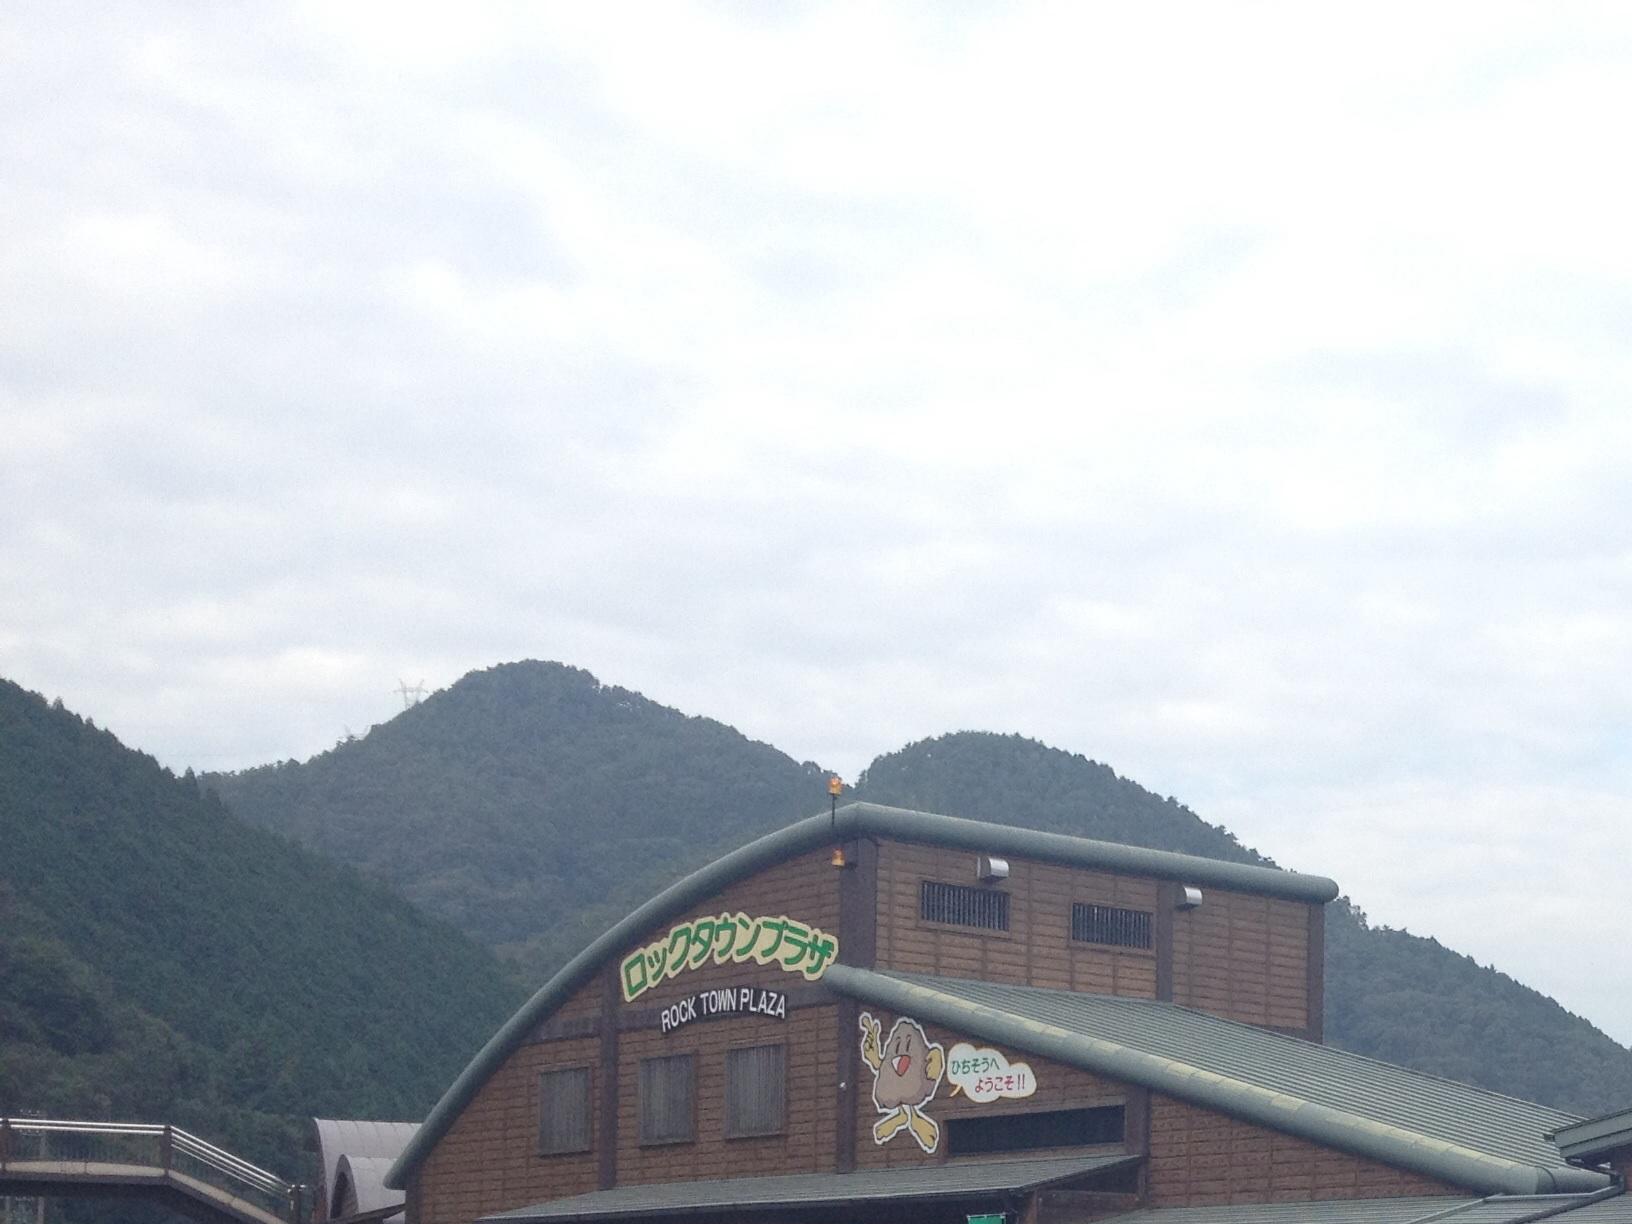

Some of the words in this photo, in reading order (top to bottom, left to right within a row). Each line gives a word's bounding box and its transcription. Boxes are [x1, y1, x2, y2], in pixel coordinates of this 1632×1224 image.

[624, 917, 834, 997] ロックタウンプラザ
[661, 997, 696, 1032] ROCK
[700, 988, 736, 1014] TOWN
[740, 988, 785, 1018] PLAZA
